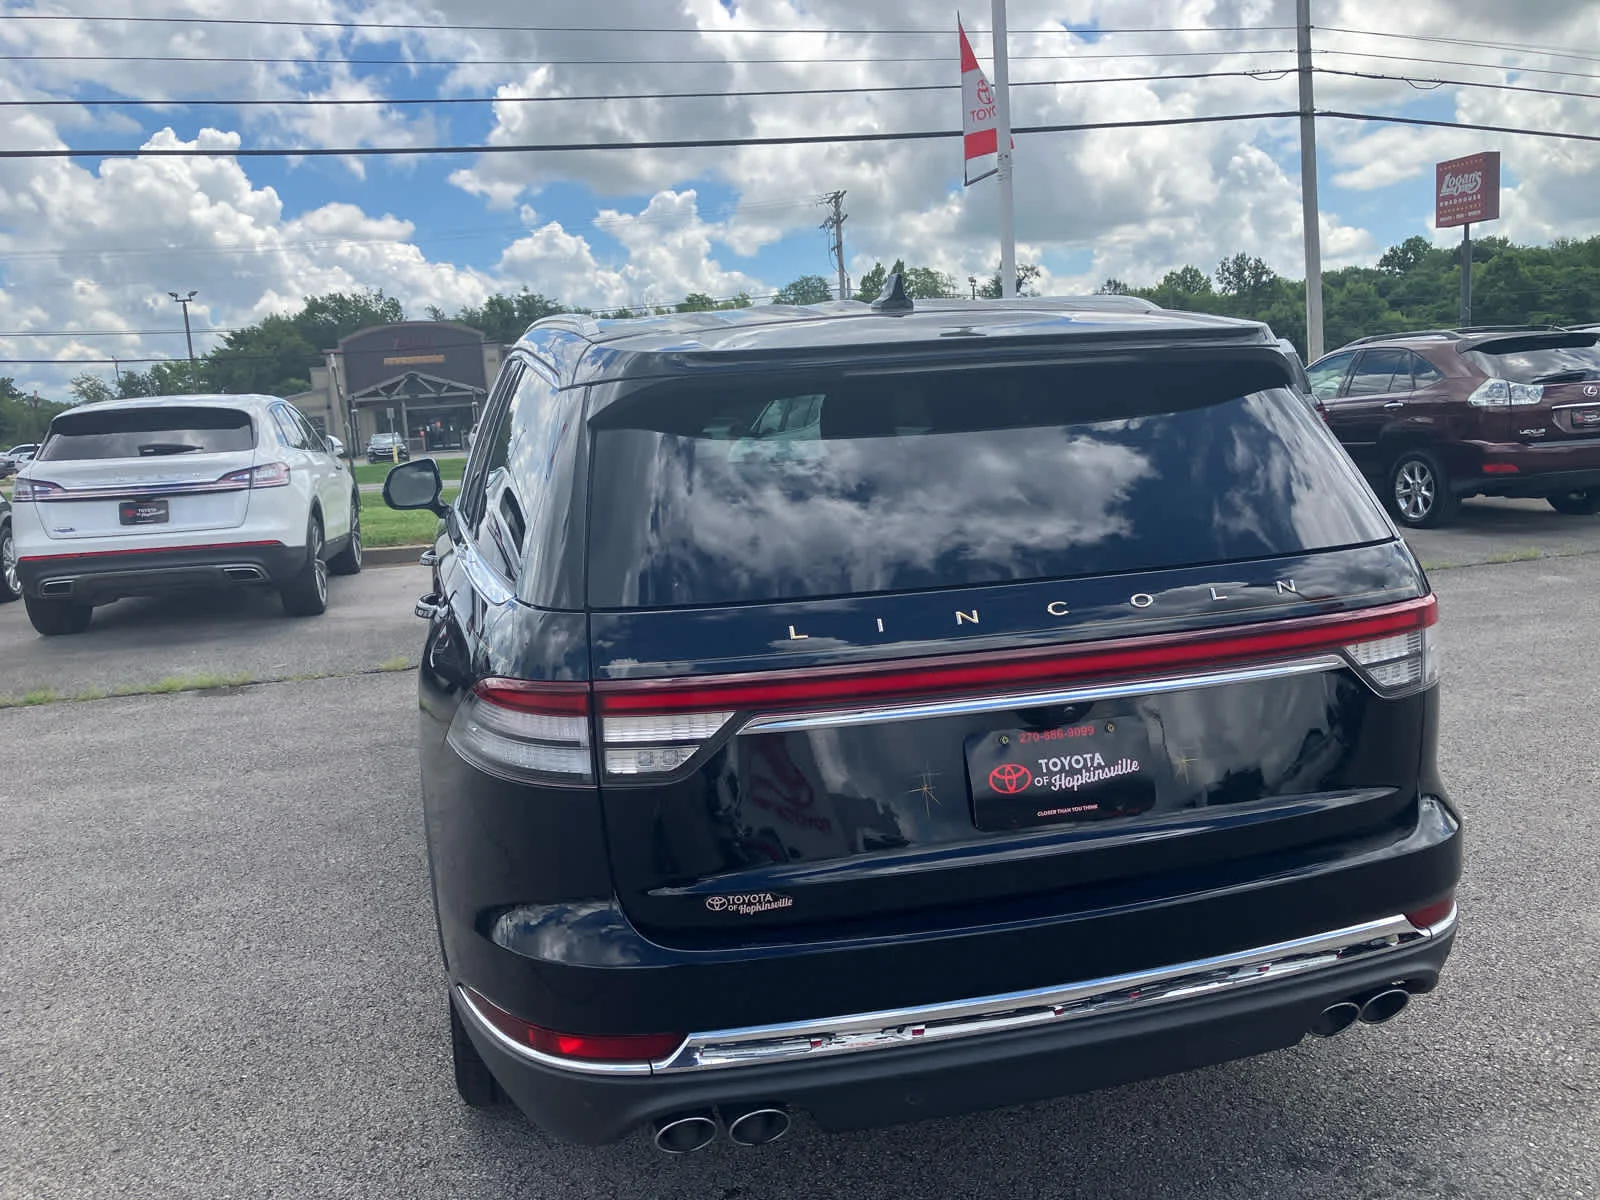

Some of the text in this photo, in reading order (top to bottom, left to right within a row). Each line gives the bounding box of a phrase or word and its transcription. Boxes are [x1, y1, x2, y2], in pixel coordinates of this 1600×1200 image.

[788, 579, 1296, 640] LINCOLN
[1038, 753, 1104, 773] TOYOTA
[1034, 758, 1139, 792] OF Hopkinsville
[1057, 807, 1071, 815] THAN
[1071, 805, 1083, 813] YOU
[728, 893, 773, 904] TOYOTA
[738, 898, 793, 915] Hopkinsville
